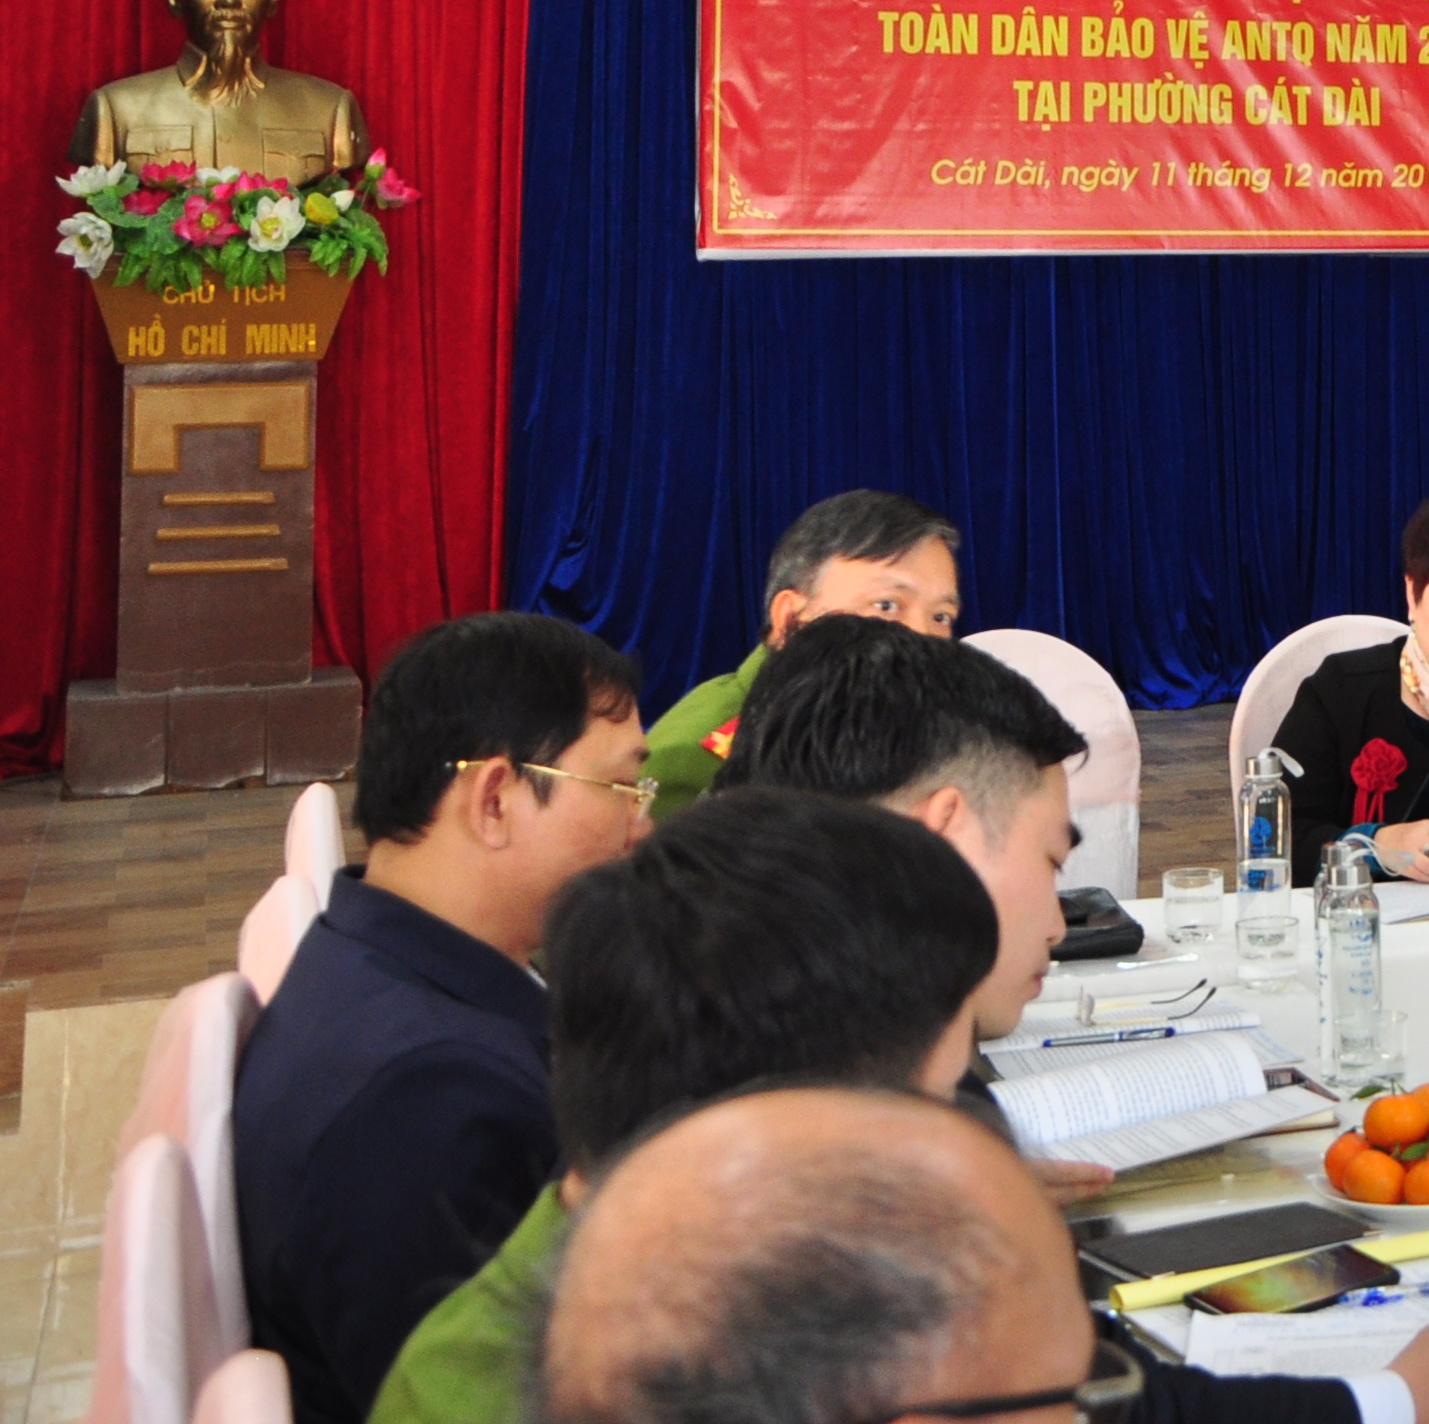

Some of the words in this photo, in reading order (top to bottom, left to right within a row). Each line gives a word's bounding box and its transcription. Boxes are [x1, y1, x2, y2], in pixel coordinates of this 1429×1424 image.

[877, 3, 979, 56] TOÀN
[991, 6, 1069, 58] DÂN
[1081, 0, 1155, 59] BẢO
[1166, 10, 1210, 69] VỆ
[1221, 19, 1315, 67] ANTQ
[1326, 15, 1408, 64] NĂM
[1013, 80, 1071, 132] TẠI
[1083, 71, 1233, 125] PHƯỜNG
[1245, 76, 1312, 126] CÁT
[1323, 77, 1381, 127] DÀI
[930, 158, 987, 186] Cát
[994, 158, 1051, 190] Dài,
[1061, 158, 1139, 193] ngày
[1151, 161, 1178, 186] 11
[1187, 160, 1272, 194] tháng
[1283, 162, 1313, 188] 12
[1320, 162, 1385, 188] năm
[127, 313, 166, 357] HỒ
[181, 318, 227, 355] CHÍ
[245, 322, 317, 355] MINH
